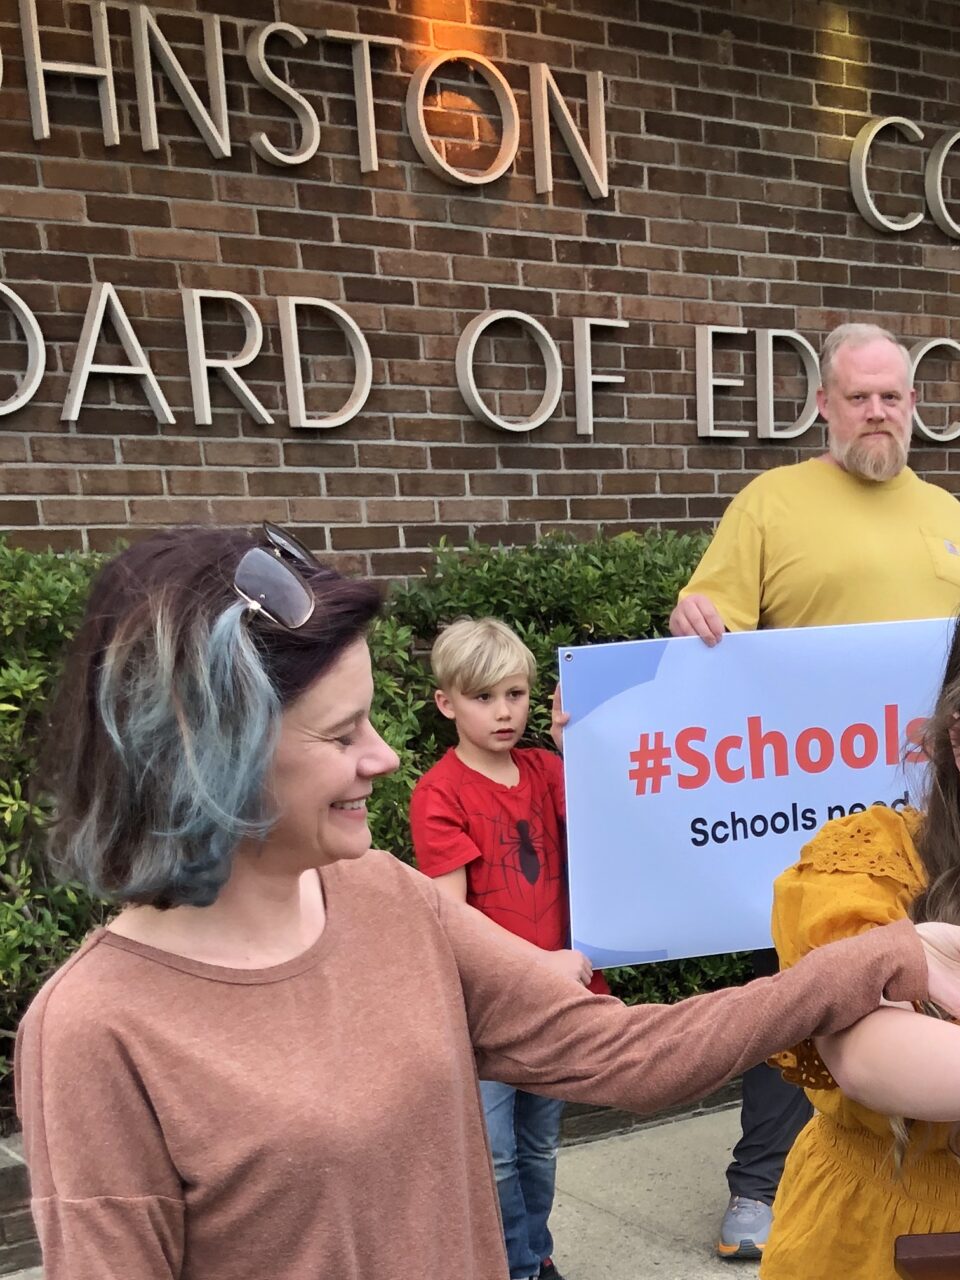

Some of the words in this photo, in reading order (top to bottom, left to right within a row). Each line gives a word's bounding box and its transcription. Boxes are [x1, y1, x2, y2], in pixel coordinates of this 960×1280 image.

[0, 0, 608, 199] HNSTON
[456, 310, 629, 435] OF
[690, 802, 817, 847] Schools
